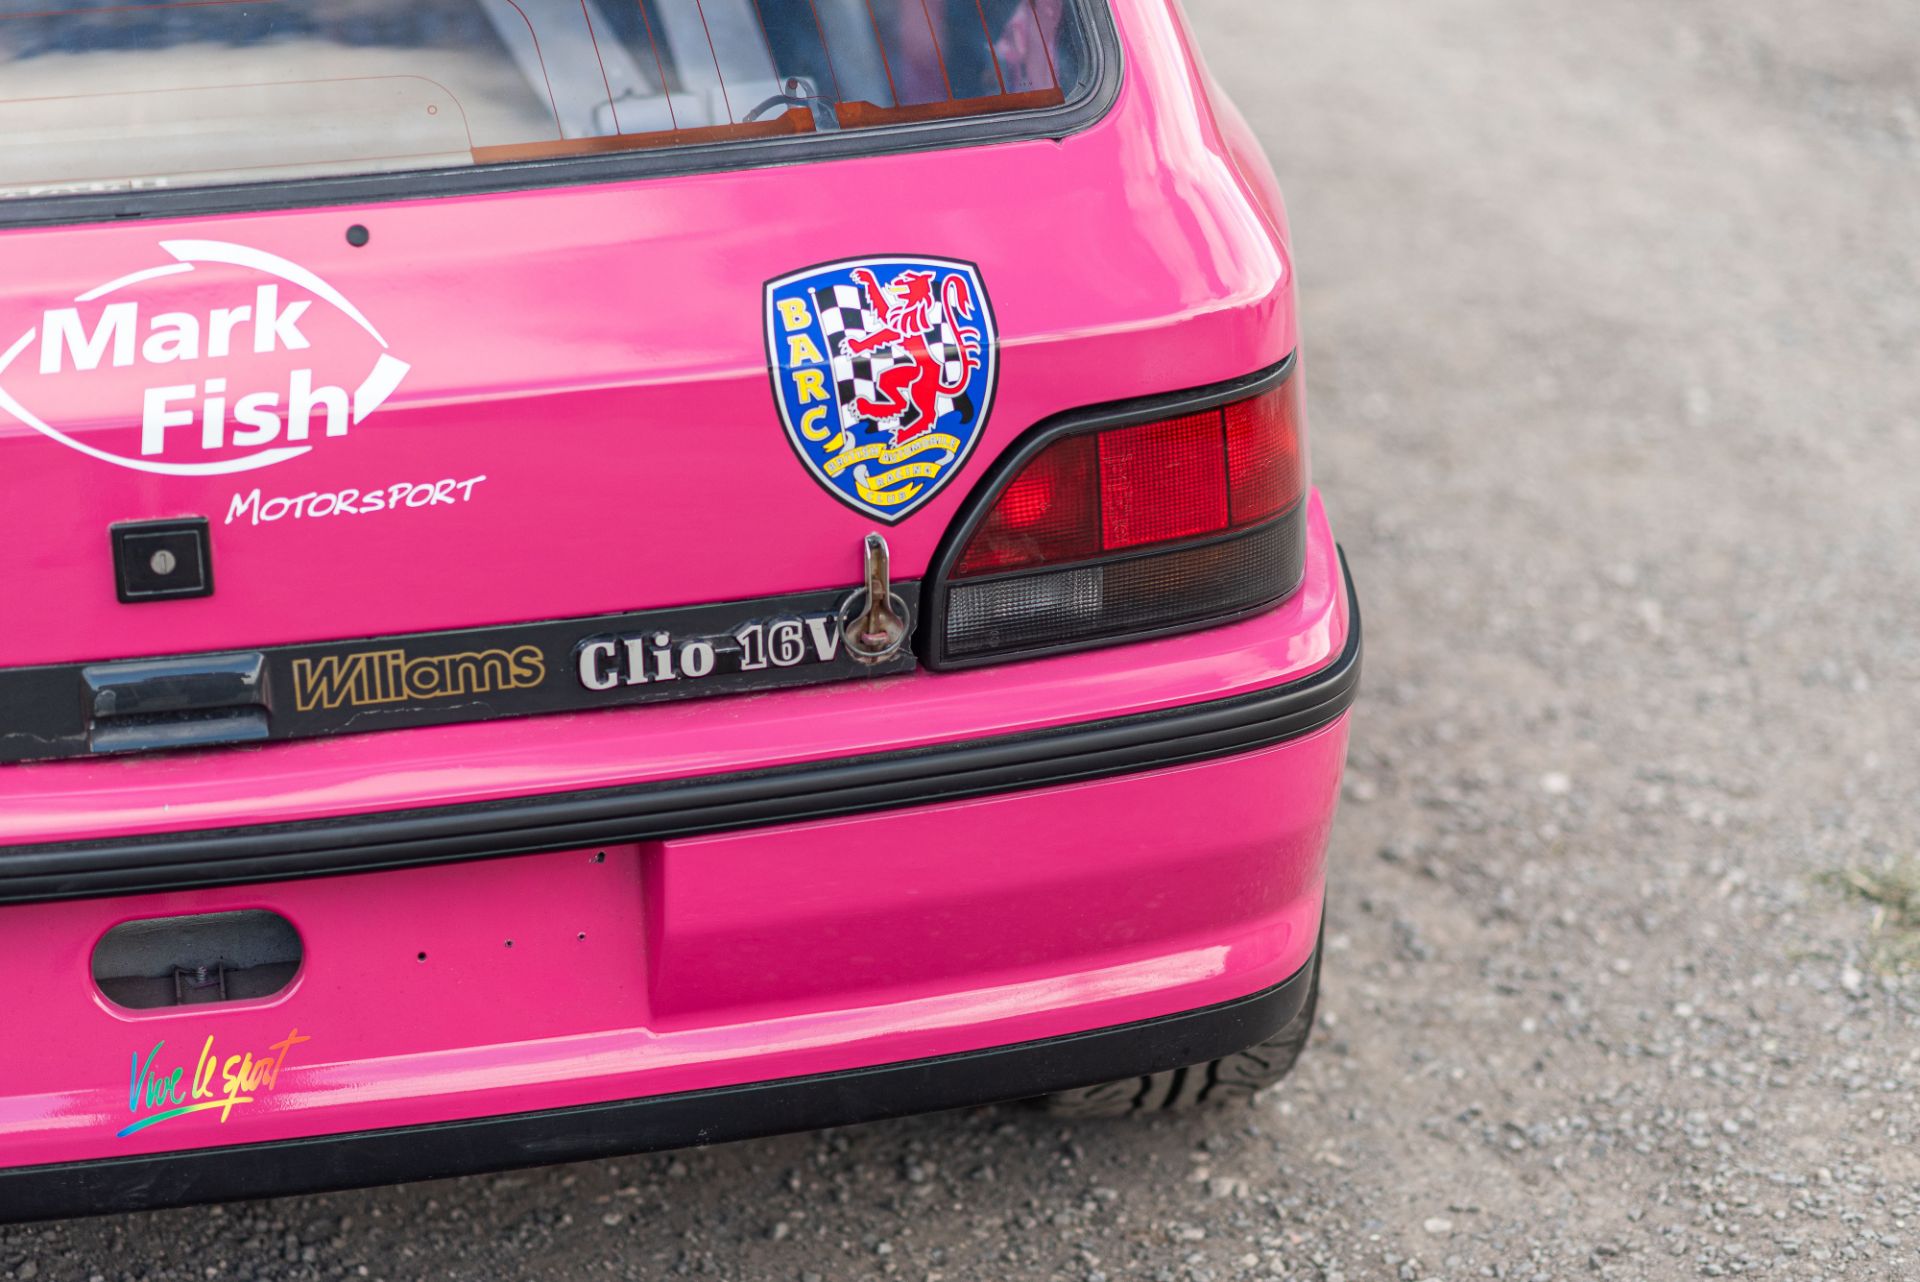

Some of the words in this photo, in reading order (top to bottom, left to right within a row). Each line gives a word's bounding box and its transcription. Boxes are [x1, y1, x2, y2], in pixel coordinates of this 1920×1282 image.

[40, 284, 312, 374] Mark
[777, 298, 831, 441] BARC
[141, 369, 349, 455] Fish
[827, 446, 879, 471] BRITISH
[882, 435, 956, 462] AUTOMOBILE
[876, 465, 932, 486] RACING
[866, 491, 906, 503] CLUB
[579, 634, 715, 691] Clio
[734, 615, 846, 671] 16V
[129, 1040, 187, 1112] Vive
